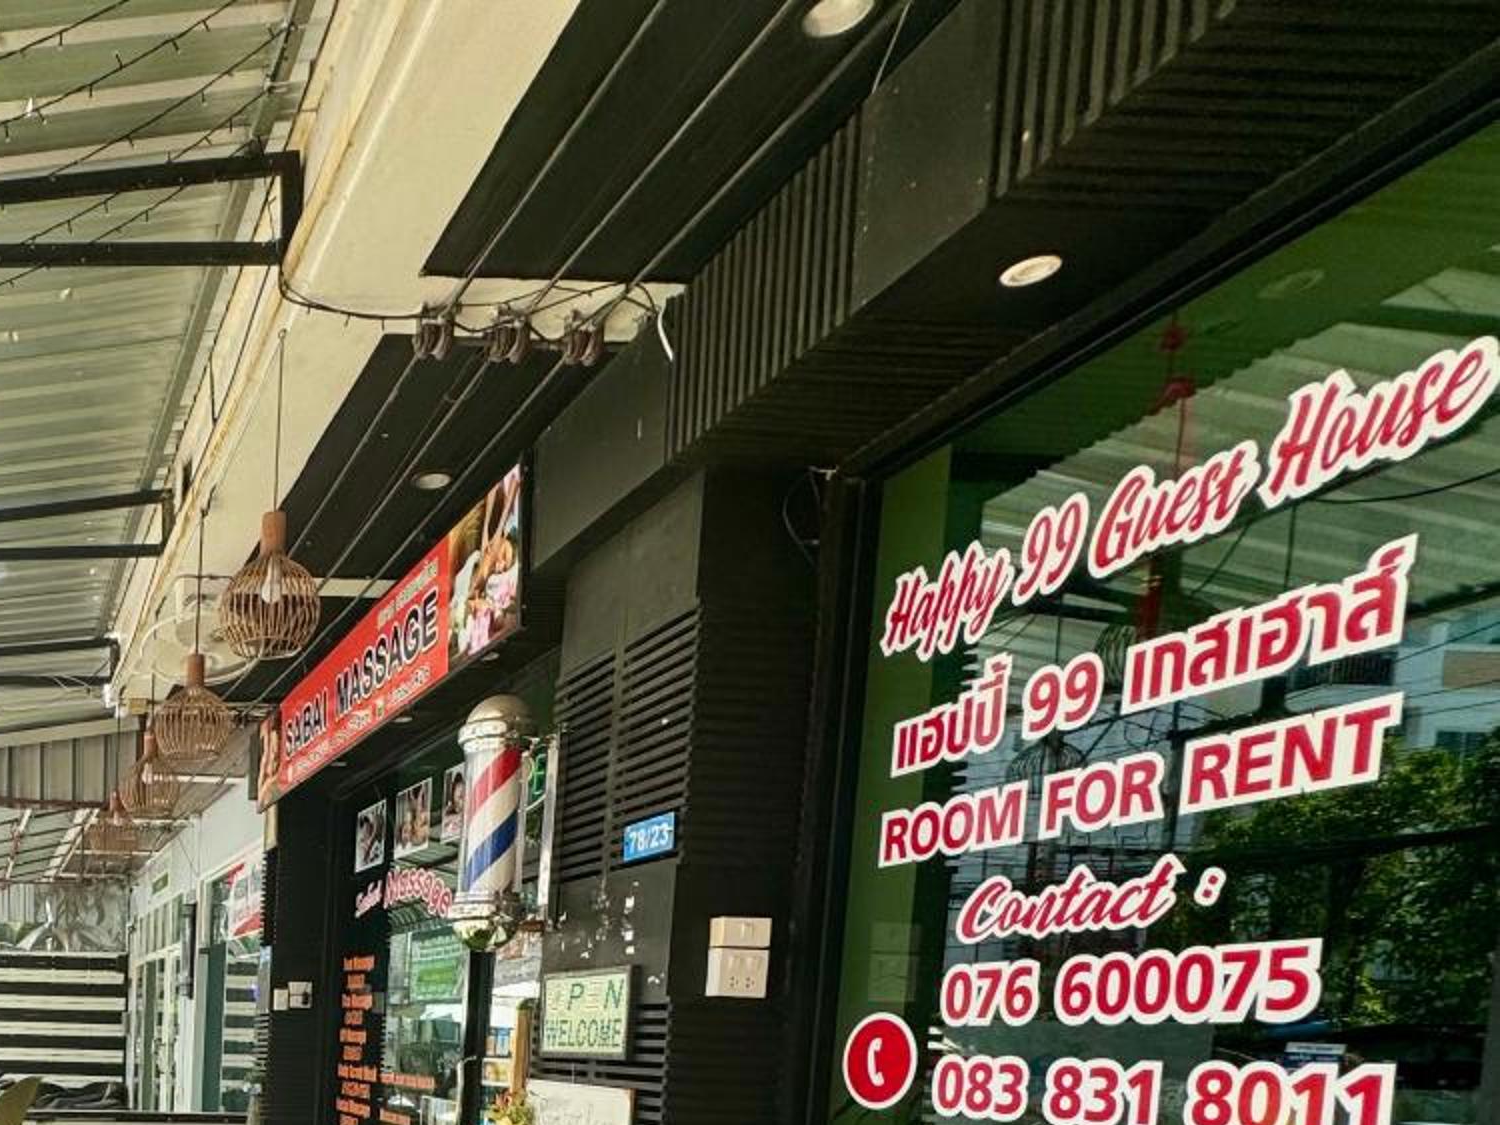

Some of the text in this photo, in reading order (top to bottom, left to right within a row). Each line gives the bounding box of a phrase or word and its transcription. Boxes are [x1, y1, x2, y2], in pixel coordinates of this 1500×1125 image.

[884, 339, 1497, 654] Happy 99 Guest House
[286, 687, 329, 760] SABAI
[335, 586, 438, 720] MASSAGE
[1026, 657, 1102, 735] 99
[1126, 542, 1408, 708] เกสเฮาส์
[882, 703, 1394, 864] ROOM FOR RENT
[959, 859, 1177, 941] Contact
[545, 1018, 622, 1048] WELCOME
[943, 943, 1316, 1022] 076 600075
[934, 1059, 1026, 1115] 083
